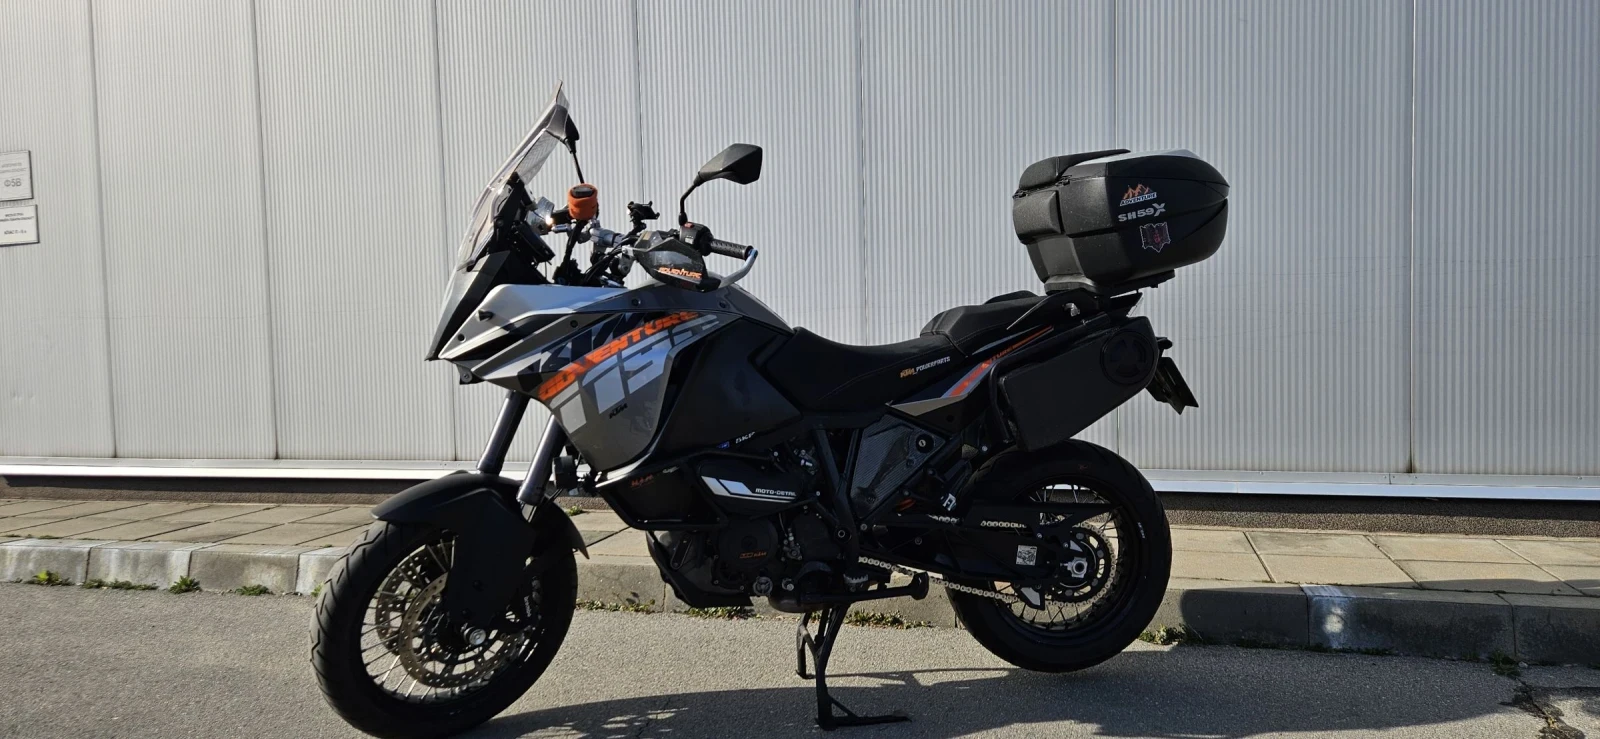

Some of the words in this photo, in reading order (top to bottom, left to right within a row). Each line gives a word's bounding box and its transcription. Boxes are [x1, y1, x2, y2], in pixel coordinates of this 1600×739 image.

[1120, 192, 1158, 207] ADVENTURE
[1117, 202, 1167, 222] SH59X
[537, 311, 699, 401] ADVENTURE
